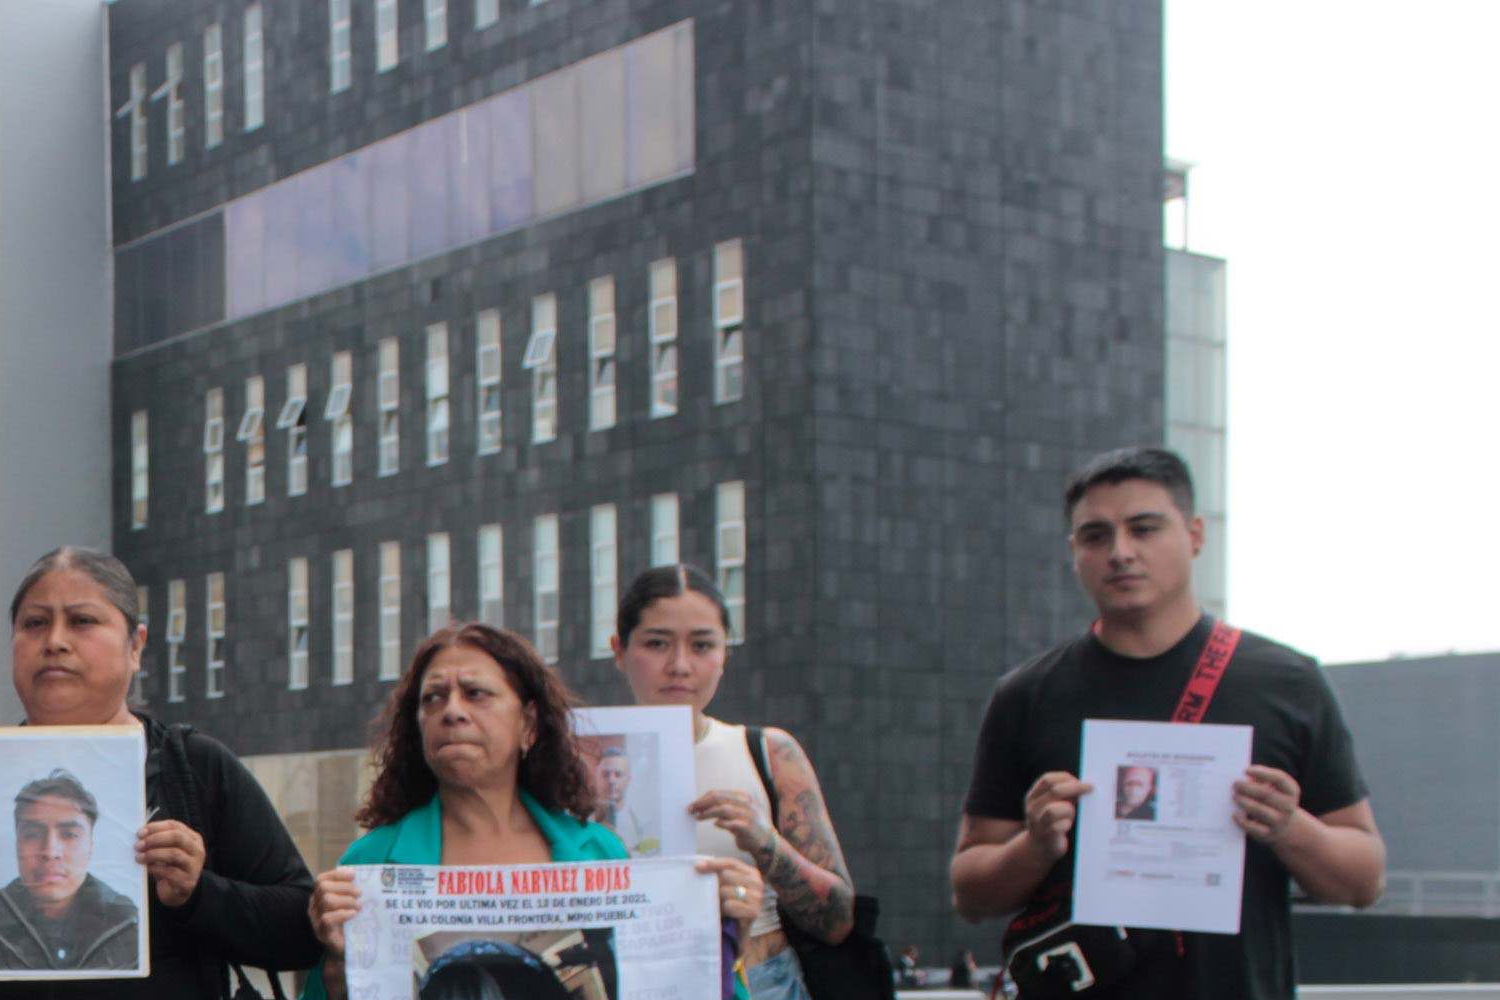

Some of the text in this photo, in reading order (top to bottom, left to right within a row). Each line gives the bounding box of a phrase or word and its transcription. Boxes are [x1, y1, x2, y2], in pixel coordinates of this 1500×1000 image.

[438, 870, 505, 895] FABIOLA
[511, 868, 578, 894] NARVAEZ
[585, 865, 631, 893] ROJAS
[385, 899, 398, 909] SE
[402, 899, 413, 909] LE
[417, 899, 433, 909] VIO
[436, 899, 456, 909] POR
[460, 899, 496, 909] ULTIMA
[500, 899, 518, 909] VEZ
[522, 899, 533, 909] EL
[553, 898, 566, 908] DE
[569, 897, 602, 908] ENERO
[605, 895, 618, 905] DE
[399, 915, 412, 924] EN
[416, 915, 428, 924] LA
[431, 915, 474, 925] COLONIA
[477, 915, 505, 925] VILLA
